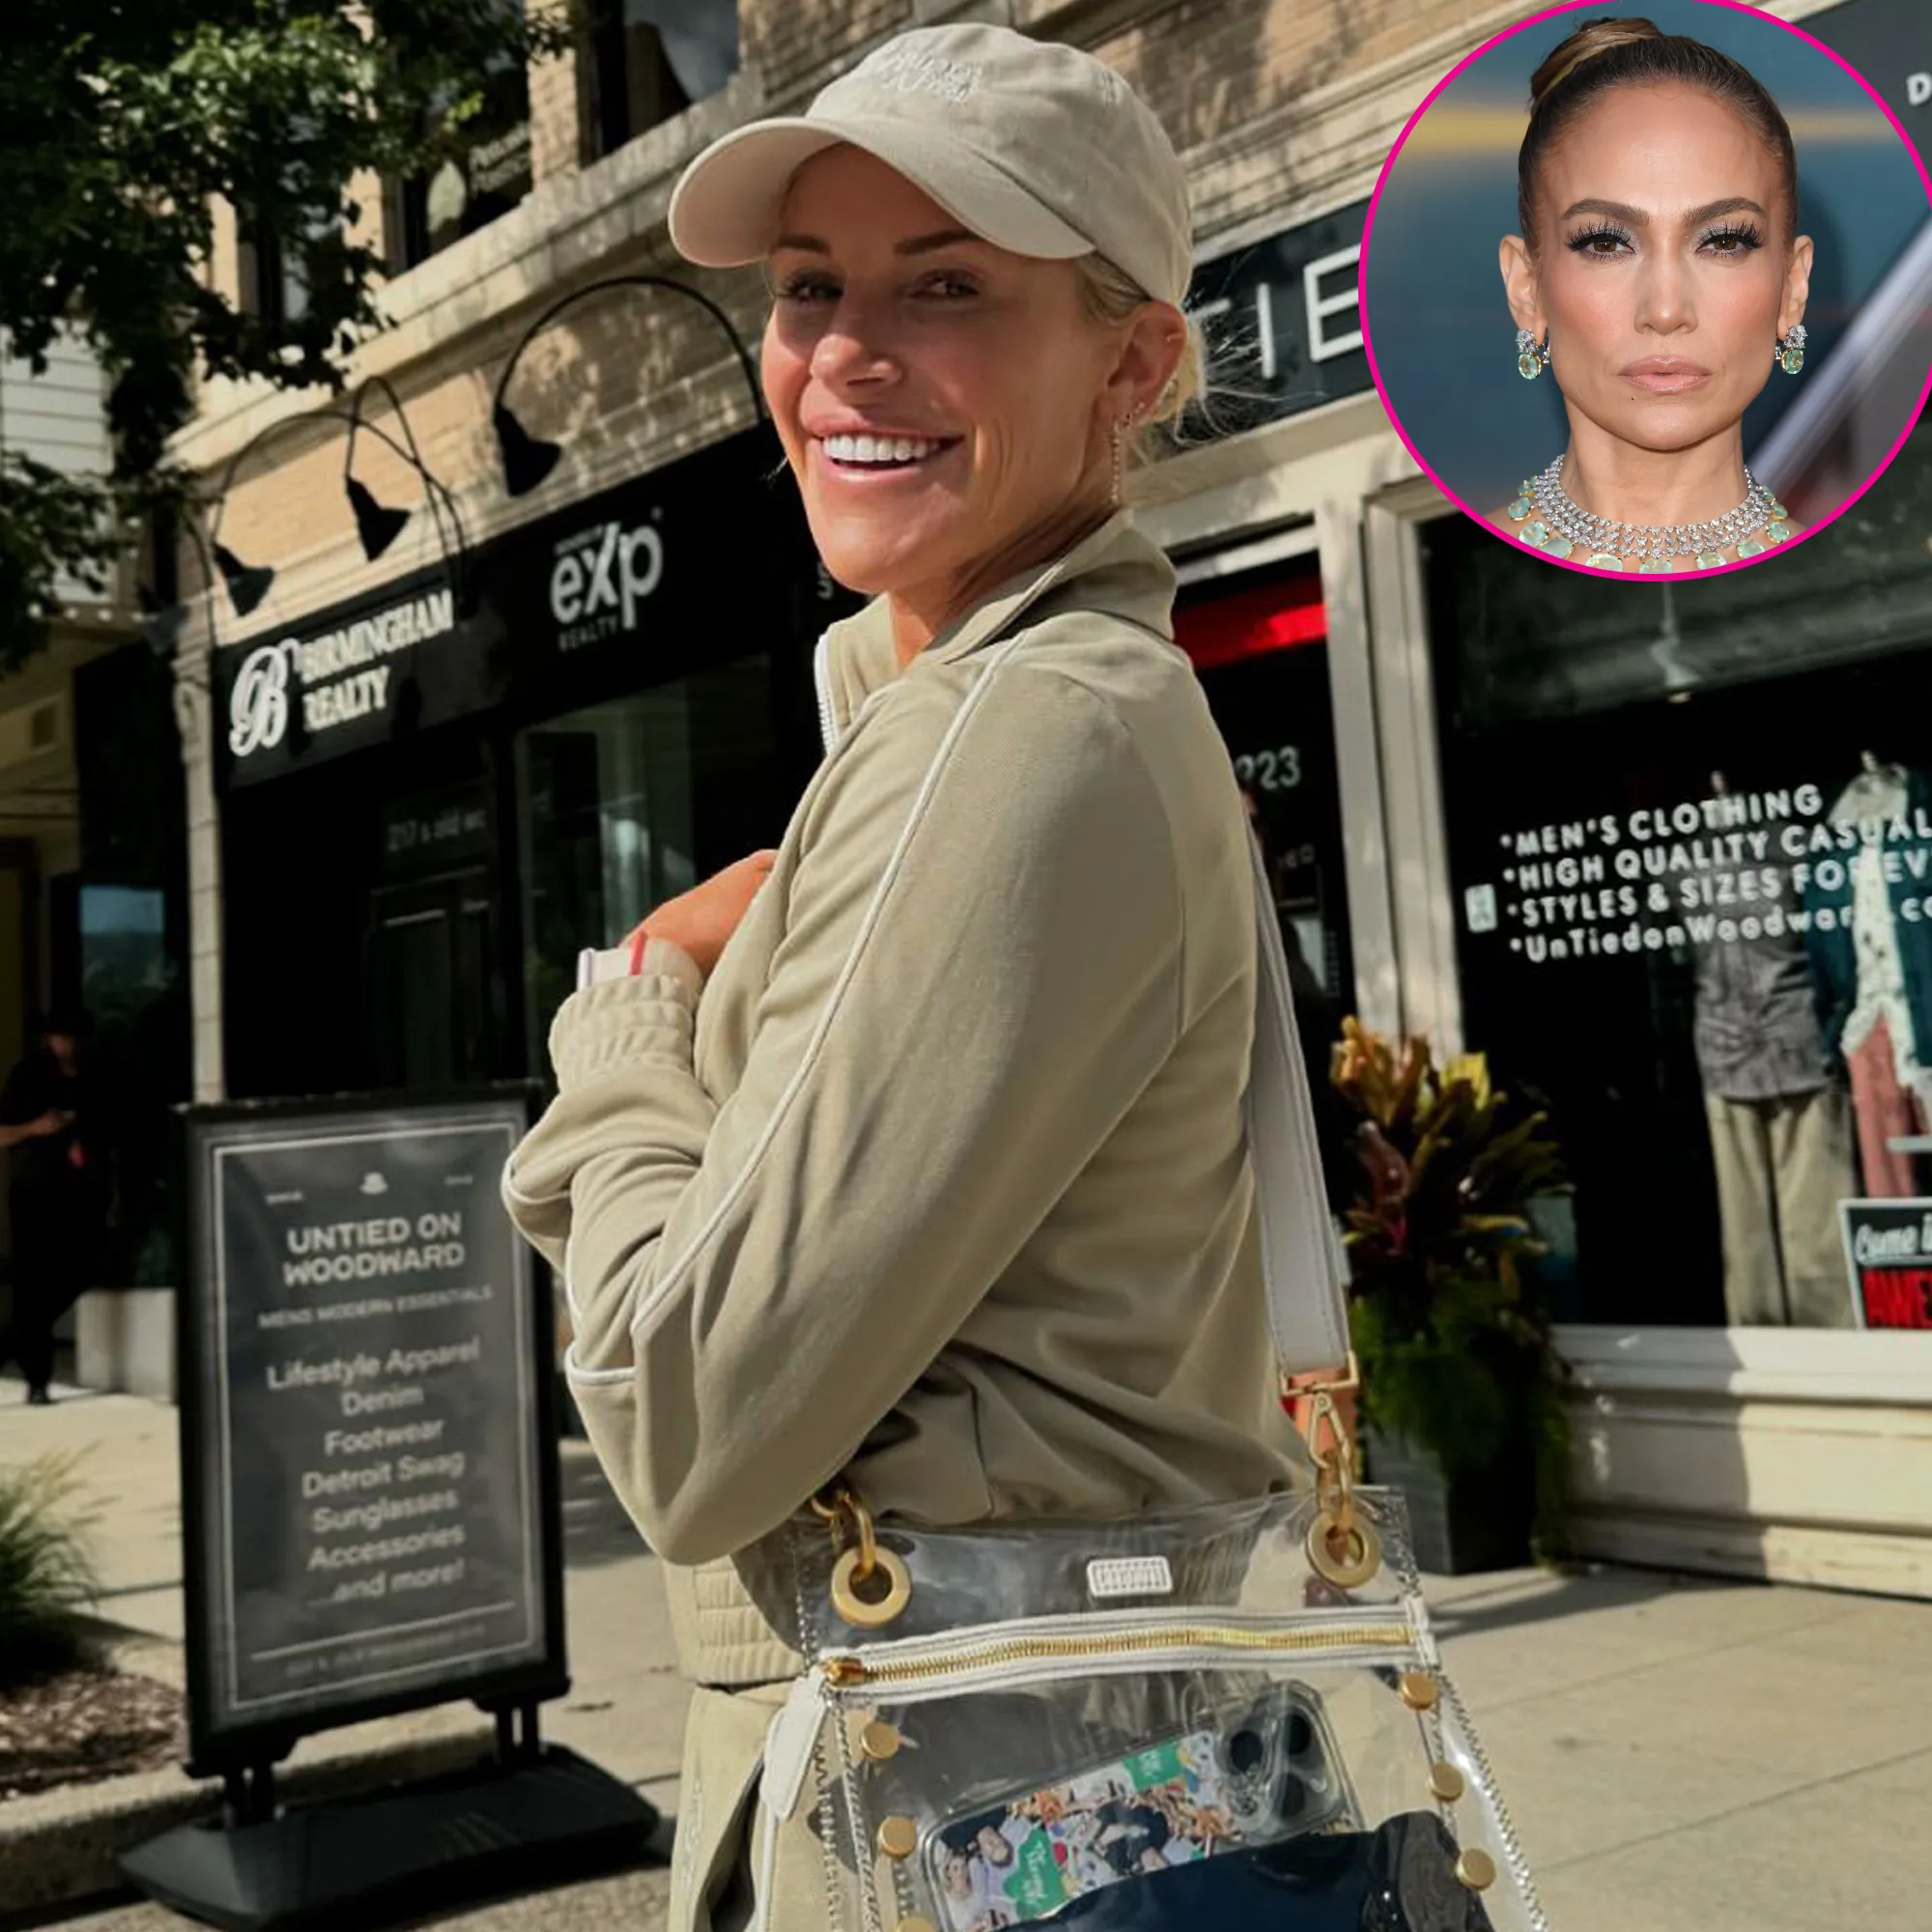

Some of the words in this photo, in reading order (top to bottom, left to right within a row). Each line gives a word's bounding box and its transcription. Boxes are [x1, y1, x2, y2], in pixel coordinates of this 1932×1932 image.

[550, 522, 664, 630] exp
[299, 589, 454, 684] BIRMINGHAM
[301, 665, 390, 731] REALTY
[1516, 814, 1620, 857] MEN'S
[1629, 783, 1823, 841] CLOTHING
[1519, 854, 1605, 892] HIGH
[1614, 831, 1769, 880] QUALITY
[1780, 808, 1932, 857] CASUAL
[1521, 885, 1638, 928] STYLES
[1647, 882, 1670, 913] &
[1679, 867, 1781, 910] SIZES
[287, 1217, 411, 1254] UNTIED
[418, 1212, 463, 1238] ON
[284, 1242, 466, 1287] WOODWARD
[267, 1351, 382, 1390] Lifestyle
[386, 1335, 480, 1376] Apparel
[341, 1383, 424, 1416] Denim
[324, 1418, 444, 1457] Footwear
[301, 1462, 392, 1498] Detroit
[313, 1490, 459, 1534] Sunglasses
[306, 1523, 467, 1572] Accessories
